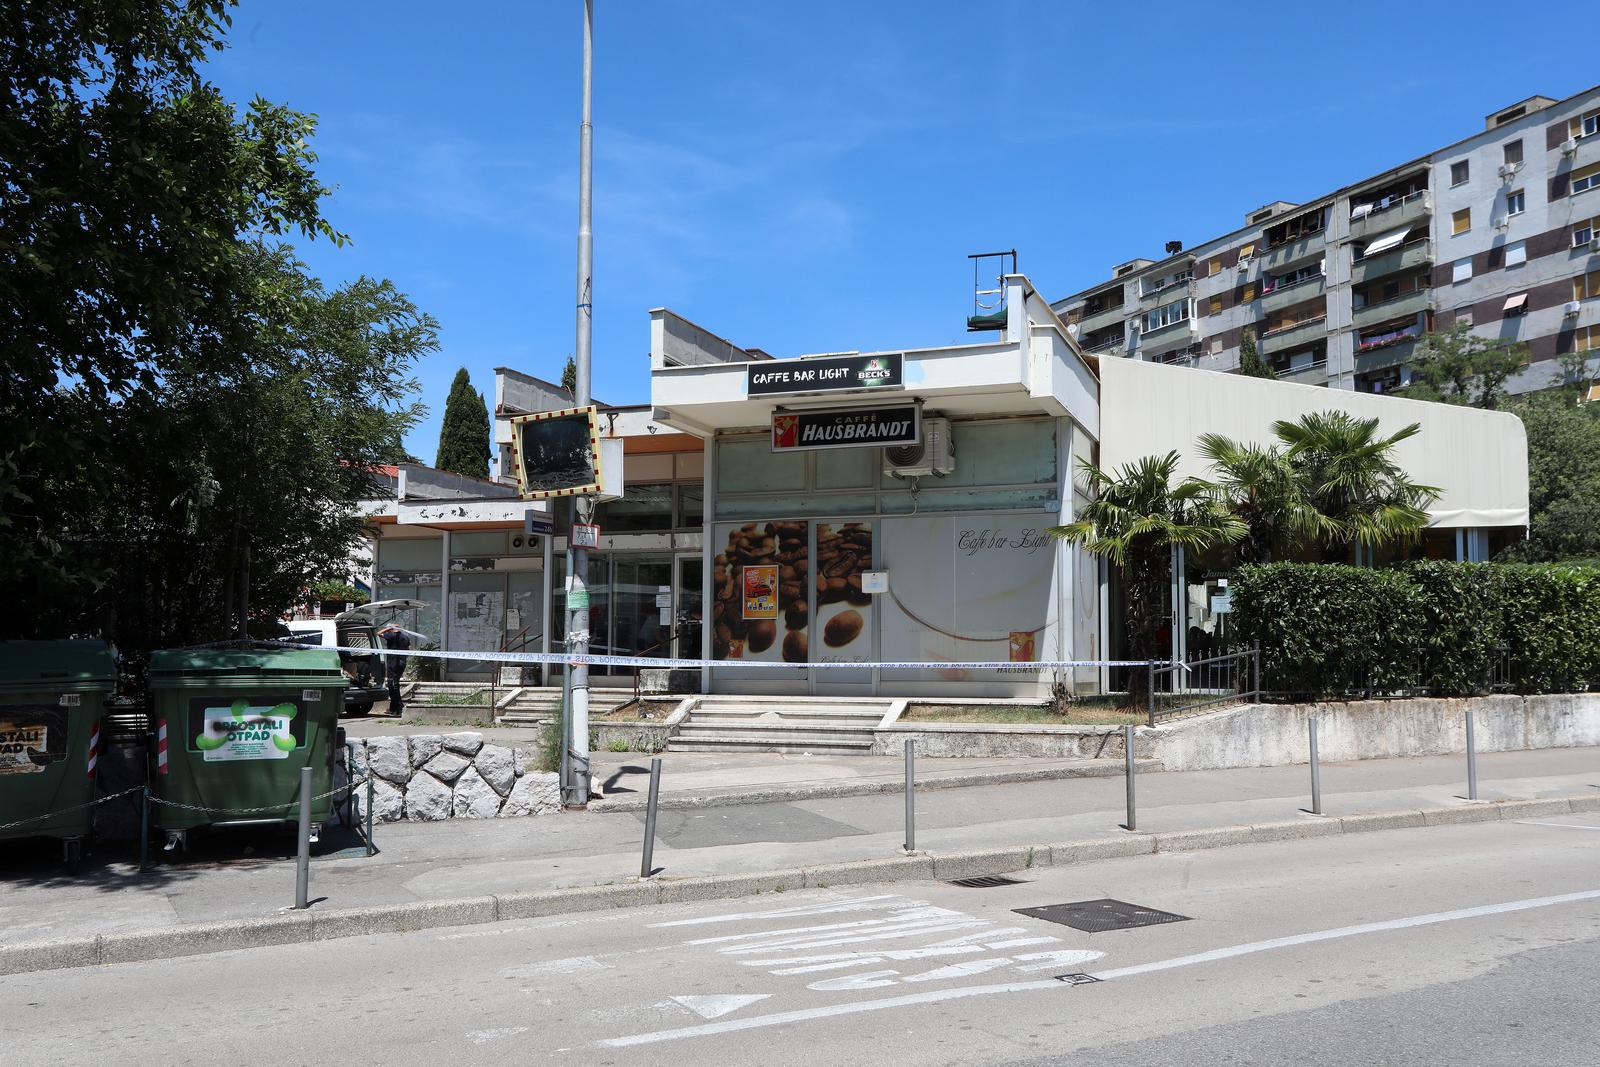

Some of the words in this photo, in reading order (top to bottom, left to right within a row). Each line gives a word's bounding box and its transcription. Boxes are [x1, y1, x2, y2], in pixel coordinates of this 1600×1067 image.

[753, 372, 790, 384] CAFFE
[793, 370, 815, 382] BAR
[819, 368, 850, 380] LIGHT
[858, 369, 891, 379] BECK'S
[802, 421, 911, 442] HAUSBRANDT
[227, 731, 270, 742] OTPAD
